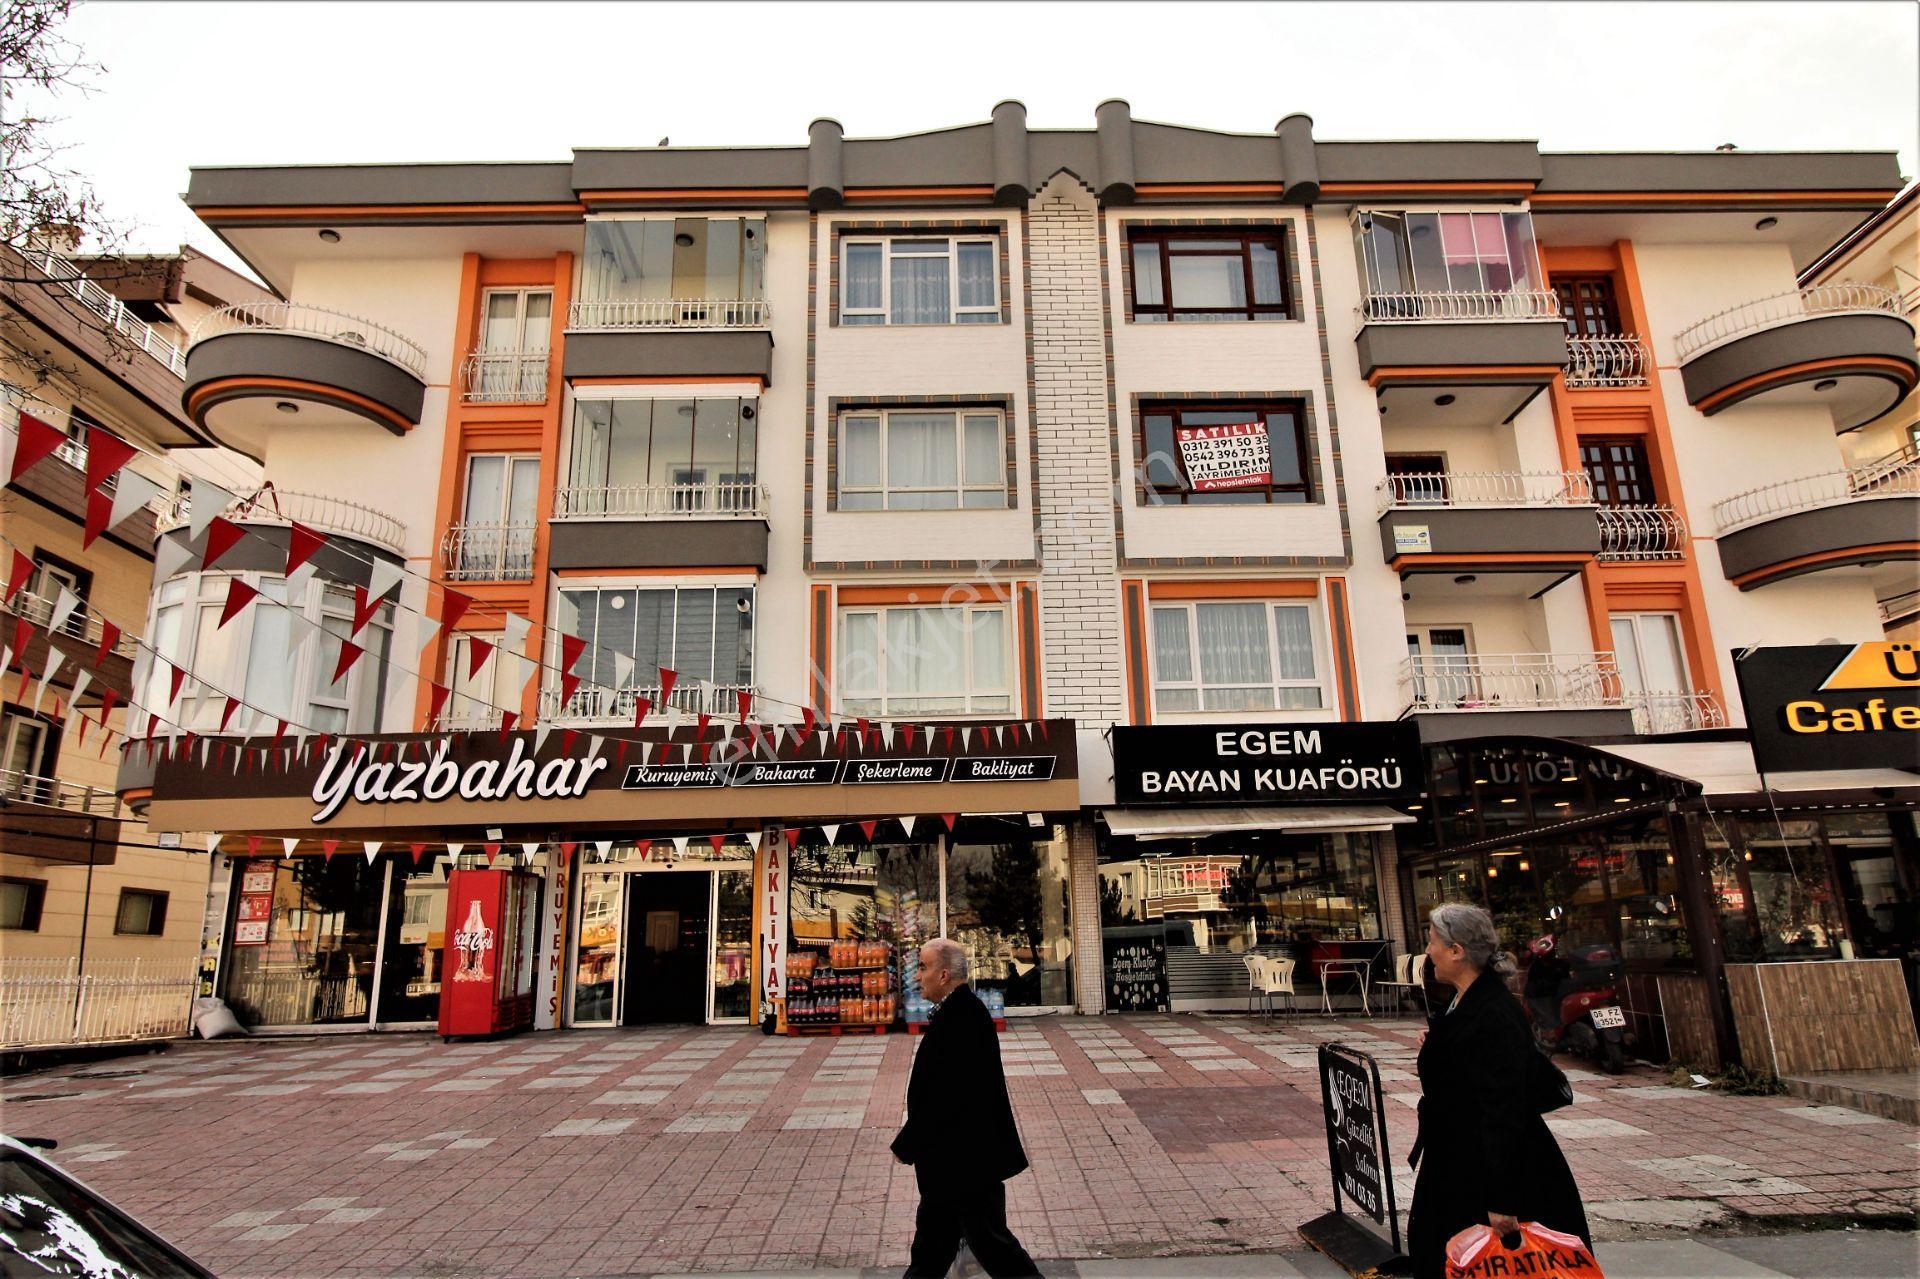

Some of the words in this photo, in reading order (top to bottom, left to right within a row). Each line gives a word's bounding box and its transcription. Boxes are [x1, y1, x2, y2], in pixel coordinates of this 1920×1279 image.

[1181, 422, 1266, 440] SATILIK
[1183, 441, 1211, 452] 0312
[1214, 439, 1232, 449] 391
[1236, 437, 1251, 447] 50
[1255, 434, 1268, 445] 35
[1185, 451, 1214, 462] 0542
[1217, 449, 1239, 459] 396
[1241, 448, 1254, 457] 73
[1257, 445, 1270, 455] 35
[1188, 457, 1270, 472] YILDIRIM
[1216, 475, 1263, 488] hepsiemlak
[1215, 730, 1322, 756] EGEM
[635, 767, 718, 787] Kuruyemiş
[755, 765, 817, 781] Baharat
[857, 763, 933, 782] Şekerleme
[971, 760, 1035, 779] Bakliyat
[1141, 769, 1241, 794] BAYAN
[1255, 758, 1402, 790] KUAFÖRÜ
[311, 738, 608, 823] Yazbahar
[549, 852, 566, 1016] URUYEMİŞ
[1337, 1069, 1371, 1111] EGEM
[1346, 1116, 1377, 1156] Güzellik
